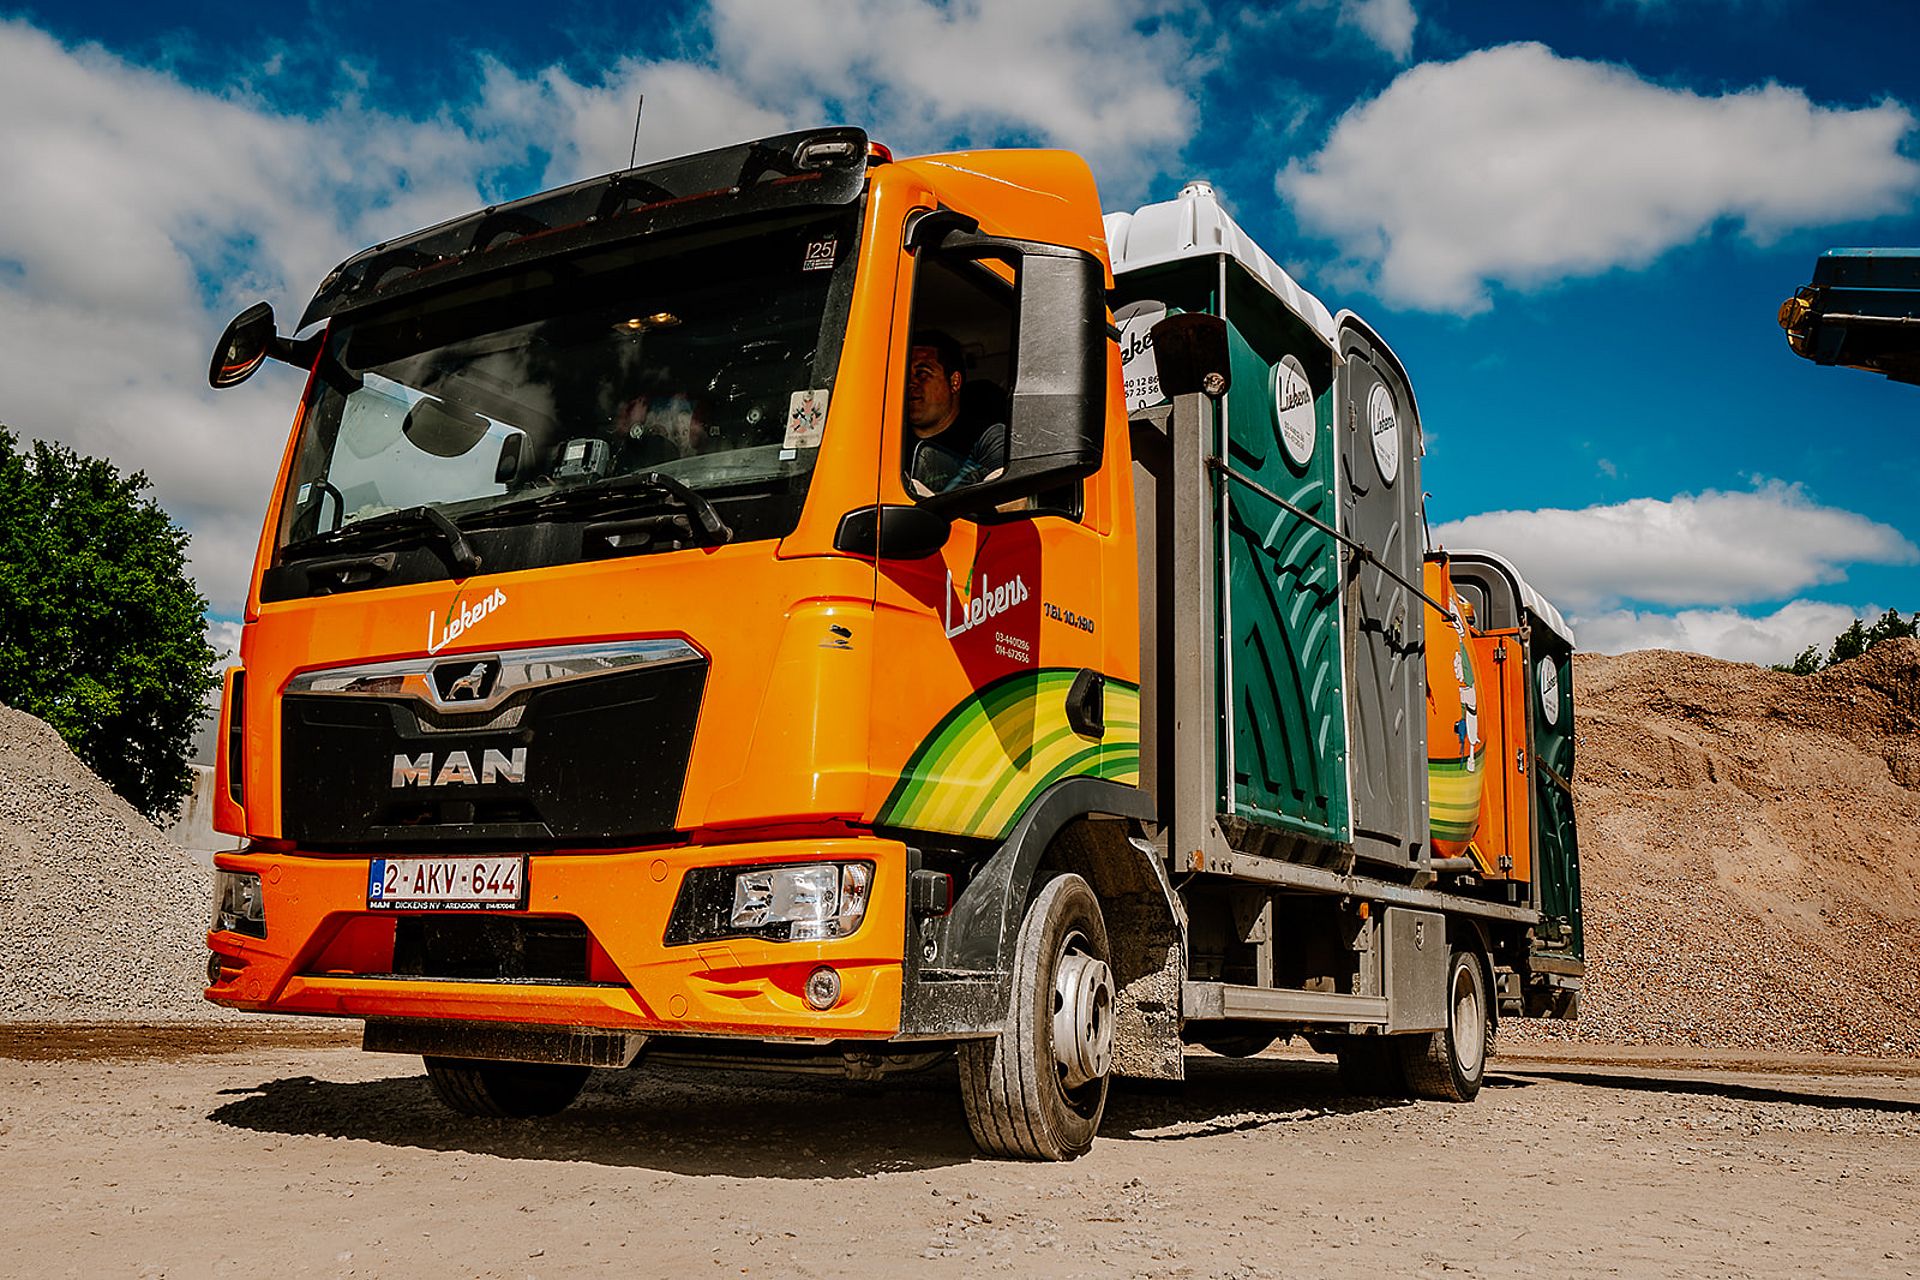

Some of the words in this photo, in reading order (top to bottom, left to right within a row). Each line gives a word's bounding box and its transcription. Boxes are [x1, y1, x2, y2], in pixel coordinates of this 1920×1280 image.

[1137, 377, 1146, 386] 12
[1136, 387, 1146, 396] 25
[1148, 385, 1159, 394] 56
[945, 569, 1030, 639] Liekens
[427, 587, 508, 655] Liekens
[391, 747, 527, 788] MAN
[372, 882, 383, 896] B
[370, 901, 390, 909] MAN
